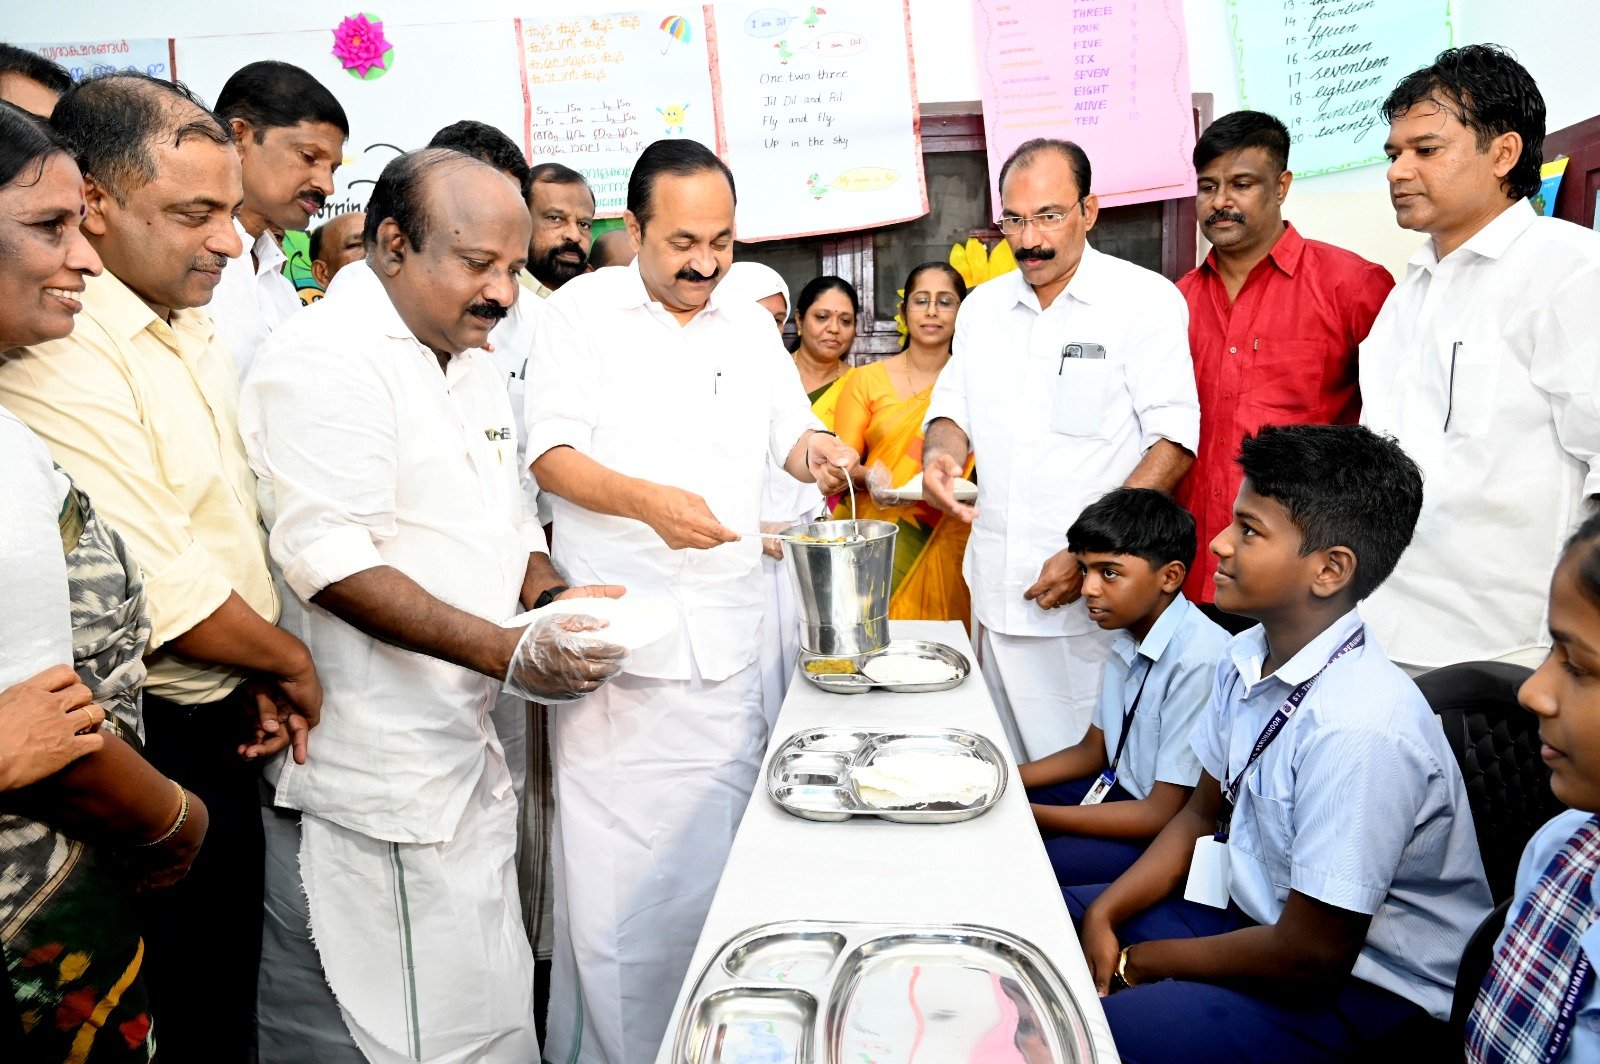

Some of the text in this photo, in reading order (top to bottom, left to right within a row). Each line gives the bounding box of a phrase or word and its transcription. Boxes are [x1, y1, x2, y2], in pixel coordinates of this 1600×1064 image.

[1073, 7, 1112, 18] THREE
[1285, 16, 1296, 26] 14
[1307, 0, 1376, 32] fourteen
[1073, 23, 1100, 35] FOUR
[1073, 39, 1102, 50] FIVE
[1286, 36, 1297, 46] 15
[1074, 54, 1095, 64] SIX
[1287, 53, 1299, 65] 16
[1308, 41, 1373, 62] sixteen
[760, 69, 849, 84] One two three
[1074, 67, 1110, 80] SEVEN
[1289, 72, 1301, 88] 17
[1309, 56, 1390, 81] seventeen
[1074, 84, 1109, 96] EIGHT
[1290, 91, 1302, 106] 18
[1311, 75, 1382, 112] eighteen
[762, 95, 777, 107] Jil
[784, 95, 797, 106] Dil
[804, 92, 822, 104] and
[1074, 100, 1108, 111] NINE
[1291, 117, 1302, 129] 19
[1313, 96, 1384, 123] nineteen
[763, 115, 778, 131] Fly
[789, 113, 808, 124] and
[1074, 115, 1099, 126] TEN
[1291, 133, 1304, 145] 20
[1314, 114, 1380, 144] twenty
[808, 136, 825, 147] the
[833, 135, 849, 150] sky
[313, 198, 368, 219] ornin
